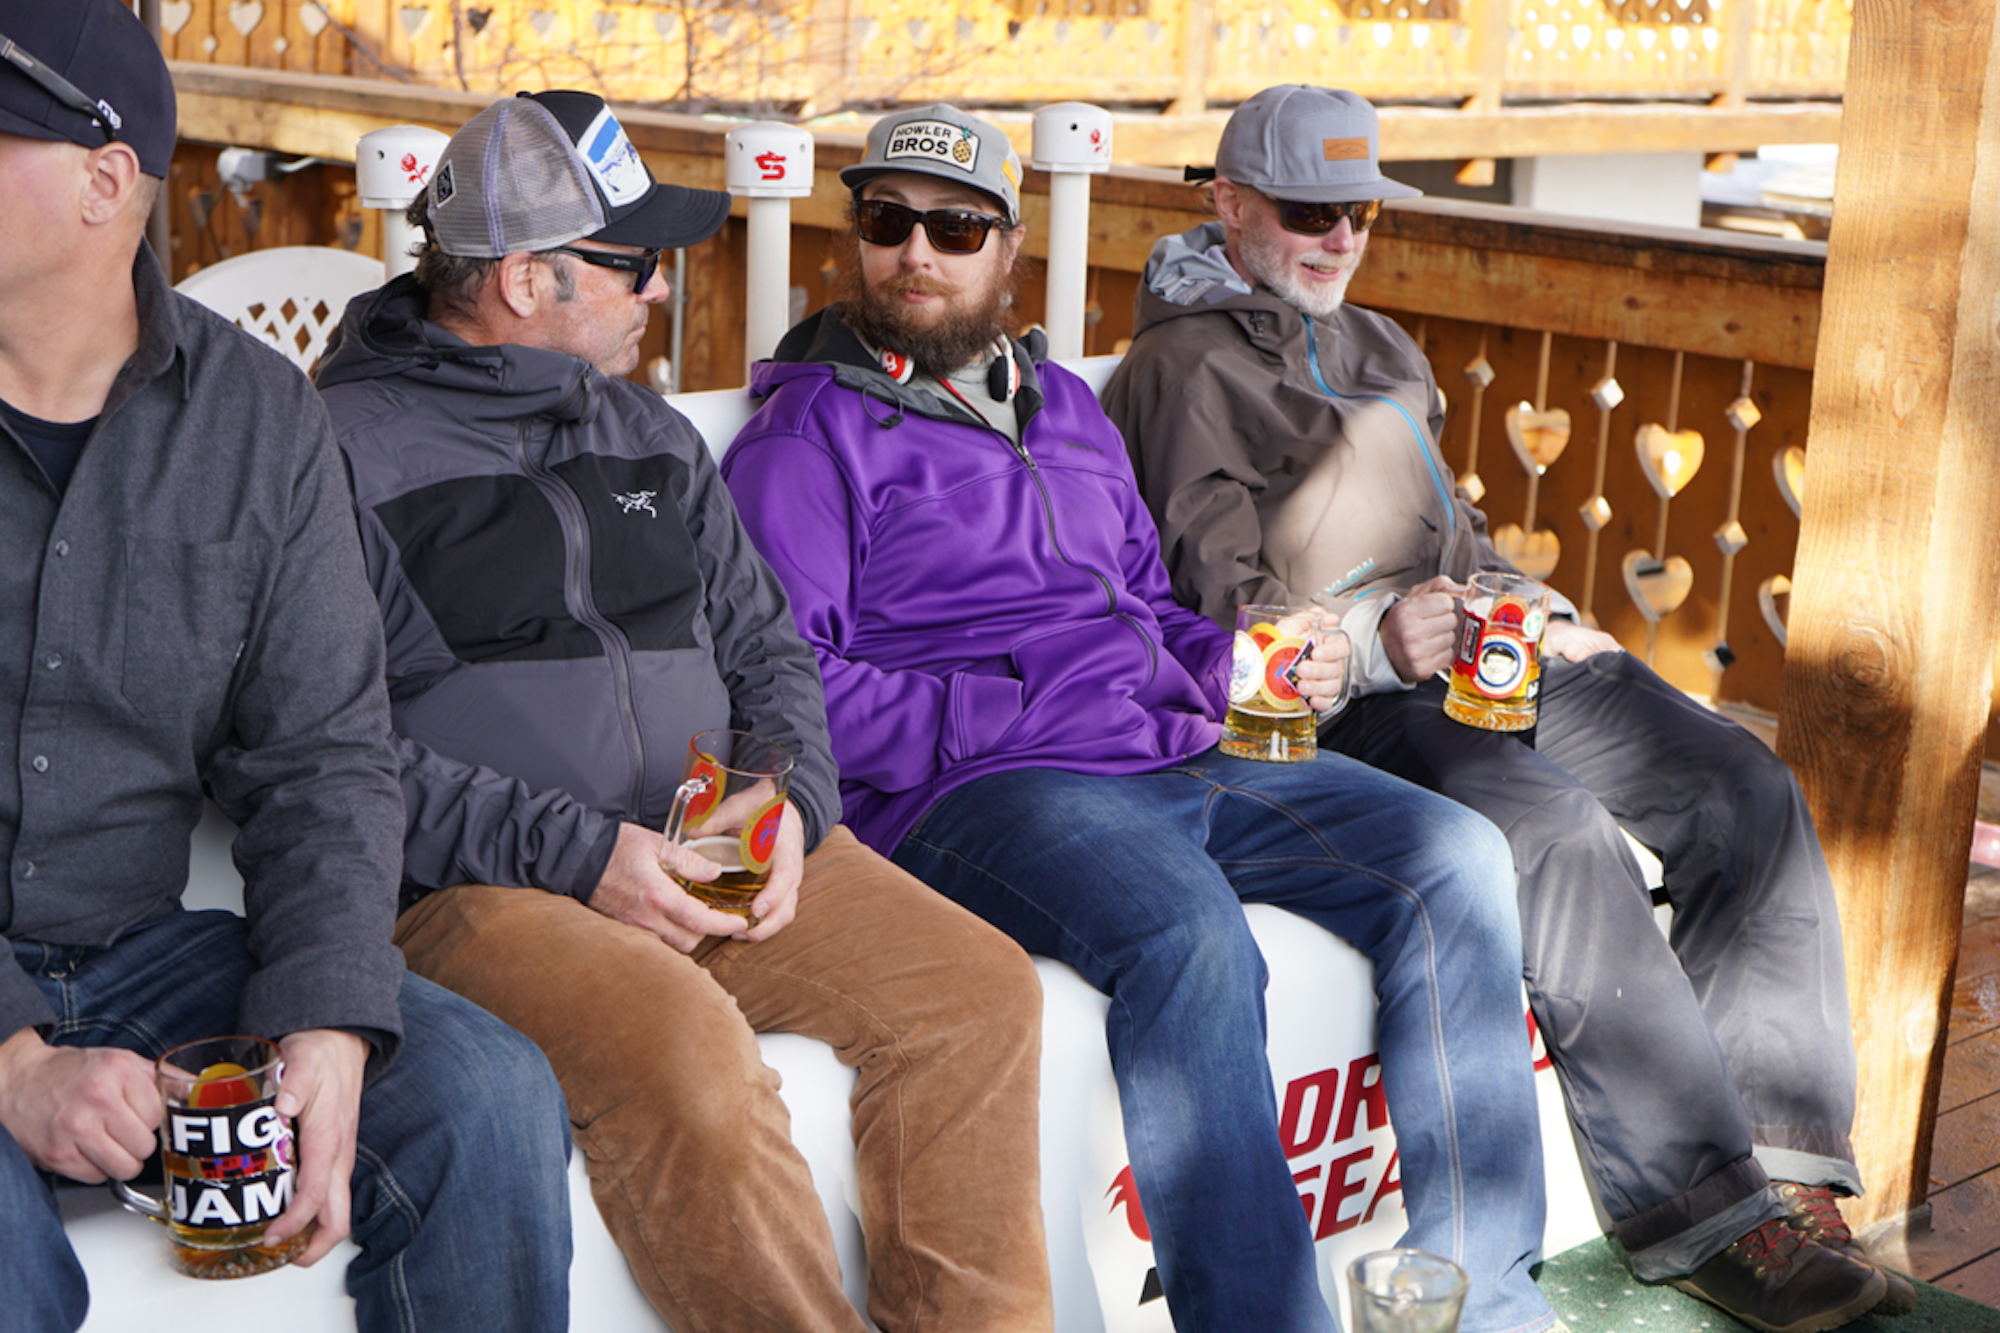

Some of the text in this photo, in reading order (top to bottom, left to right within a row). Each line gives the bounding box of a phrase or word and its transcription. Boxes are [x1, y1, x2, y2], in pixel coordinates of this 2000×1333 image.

[892, 138, 948, 155] BROS
[896, 125, 951, 138] HOWLER
[172, 1106, 279, 1153] FIG
[171, 1171, 292, 1225] JAM
